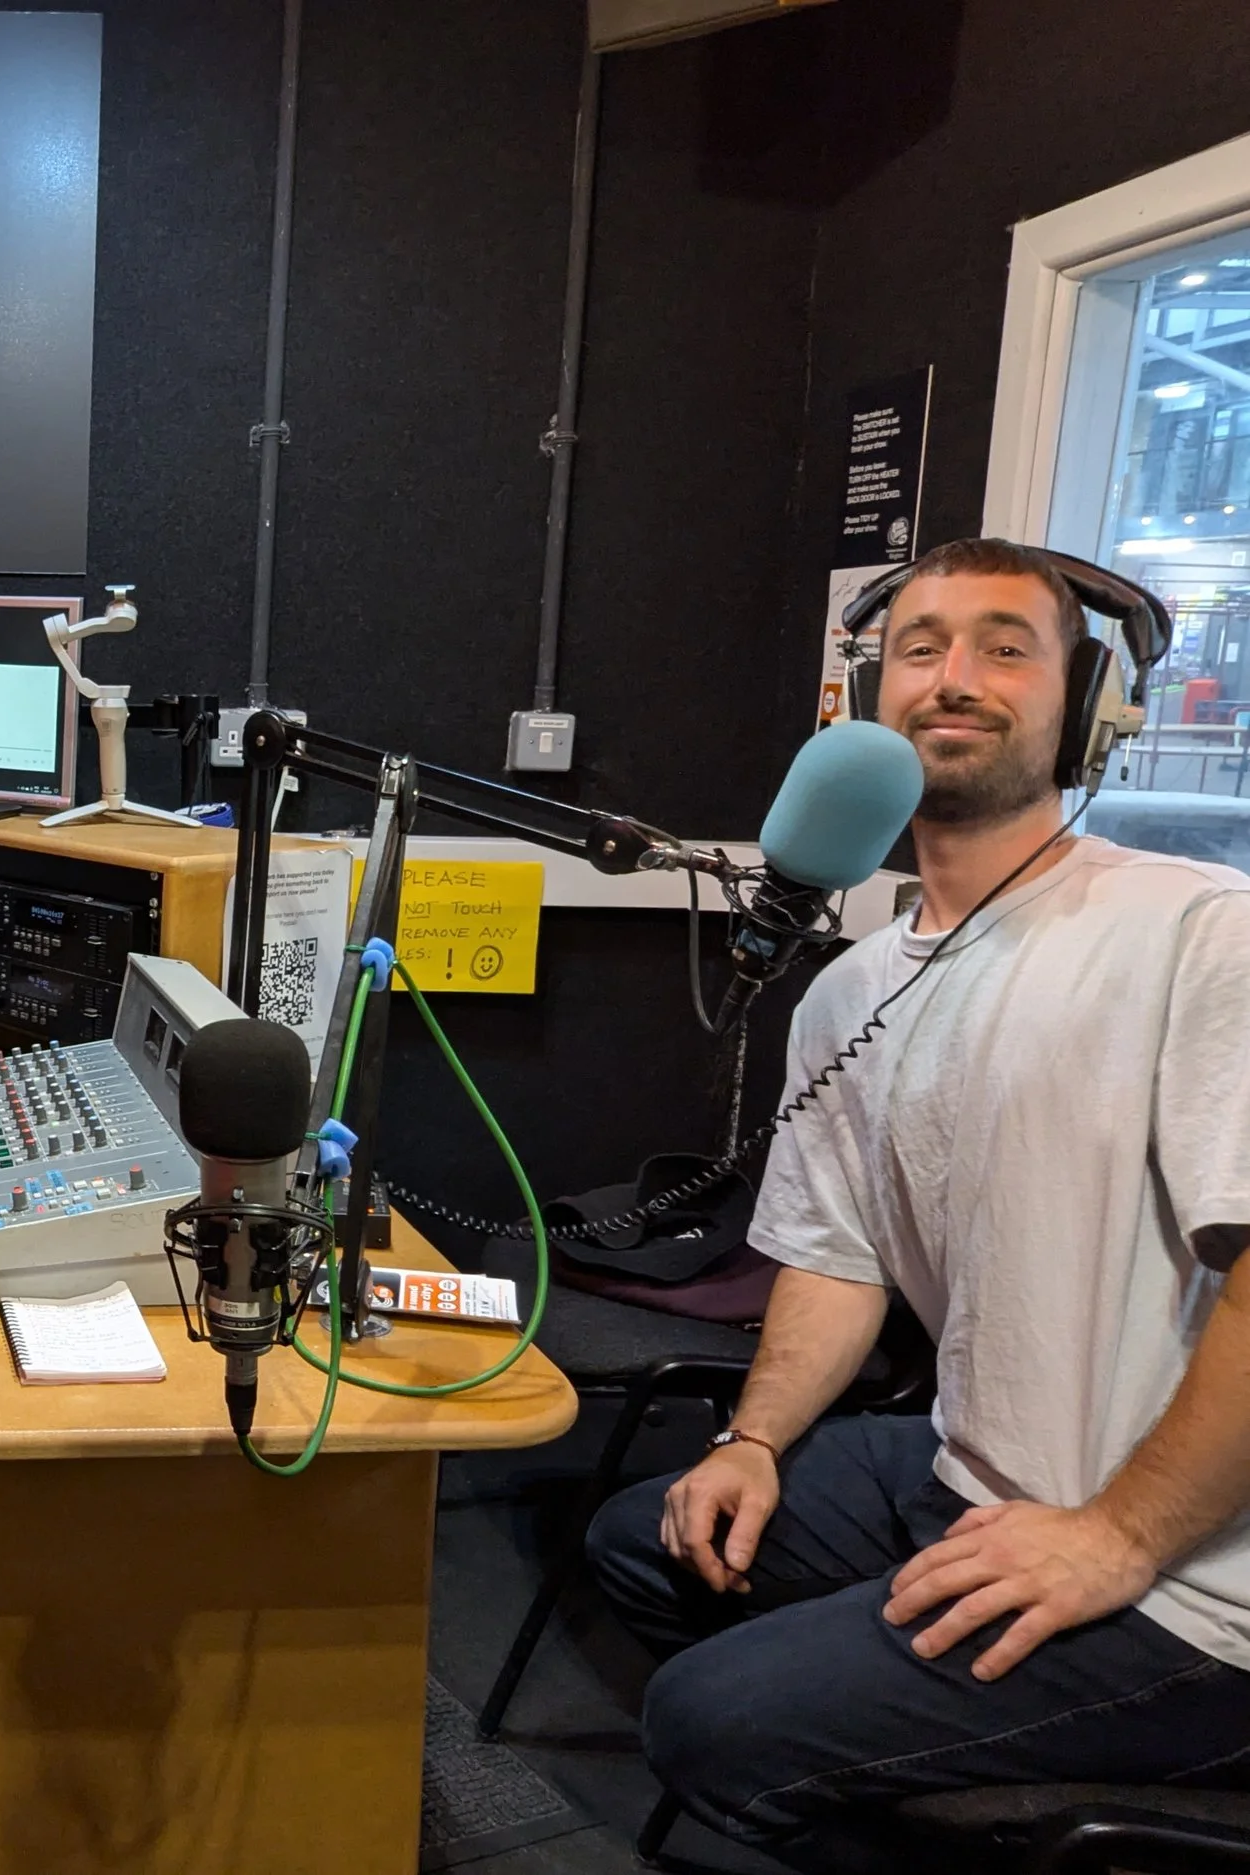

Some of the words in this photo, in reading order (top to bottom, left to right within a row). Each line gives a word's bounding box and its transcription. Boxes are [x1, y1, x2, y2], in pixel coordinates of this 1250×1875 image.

[286, 871, 311, 879] supported
[321, 869, 334, 877] today
[402, 868, 486, 888] PLEASE
[273, 882, 284, 890] give
[285, 880, 311, 888] something
[404, 900, 439, 917] NOT
[400, 927, 470, 940] REMOVE
[478, 927, 518, 940] ANY
